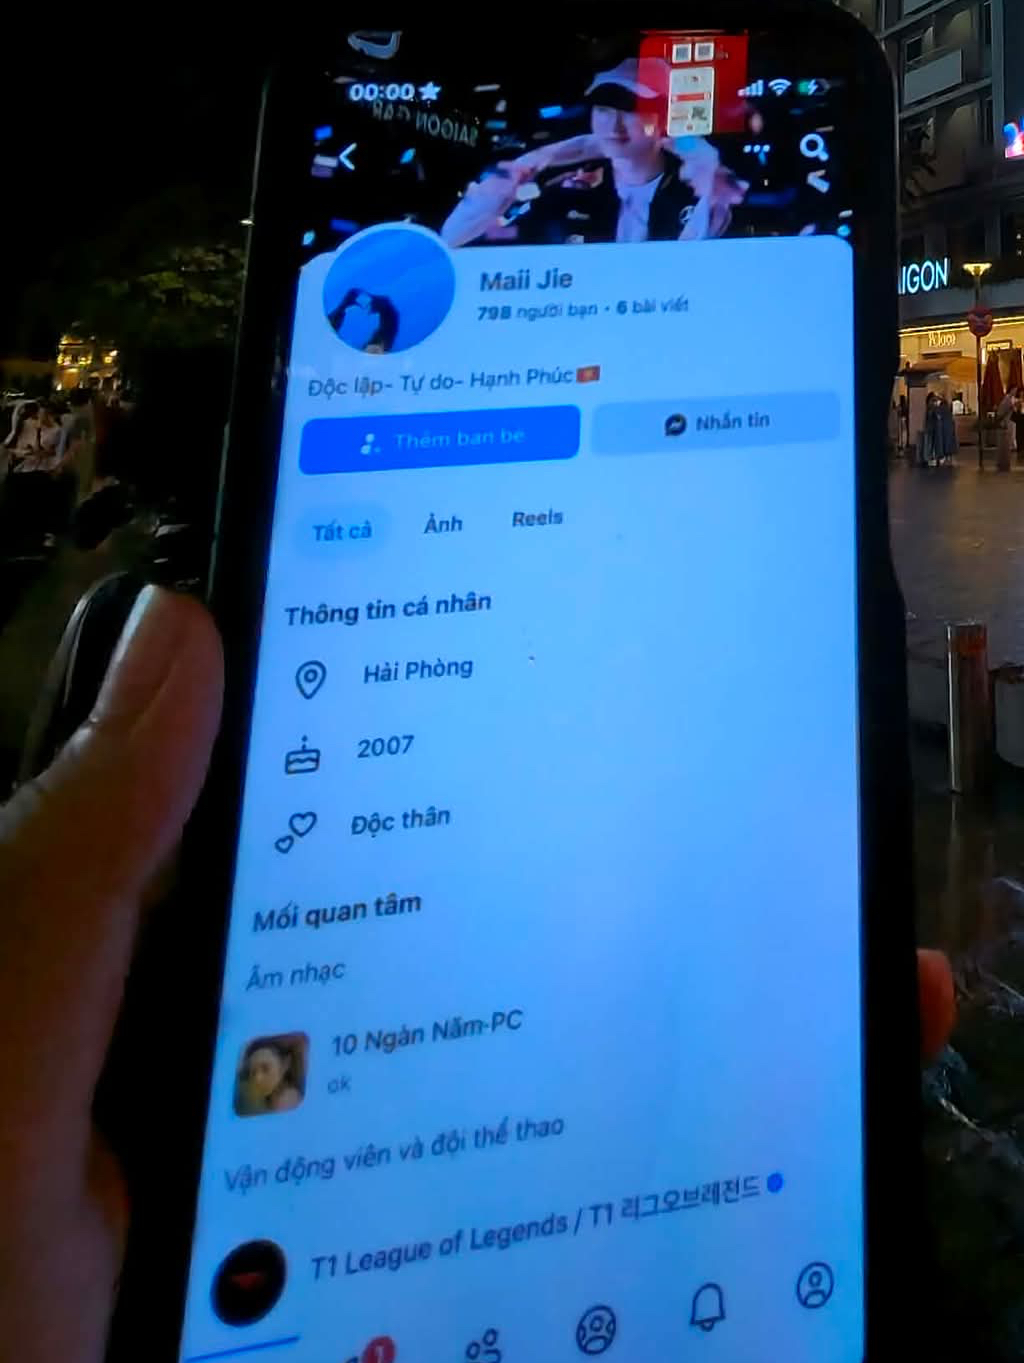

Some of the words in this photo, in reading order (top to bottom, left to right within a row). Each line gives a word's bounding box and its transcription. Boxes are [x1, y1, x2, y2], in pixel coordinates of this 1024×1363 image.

[349, 83, 416, 102] 00:00
[479, 269, 531, 292] Maii
[536, 267, 574, 289] Jie
[898, 256, 949, 295] IGON
[477, 305, 512, 321] 798
[566, 301, 599, 320] bạn
[616, 299, 629, 315] 6
[308, 378, 348, 400] Độc
[400, 374, 426, 395] Tự
[470, 370, 521, 391] Hạnh
[526, 366, 575, 384] Phúc
[748, 411, 771, 428] tin
[313, 518, 343, 542] Tất
[423, 512, 463, 534] Ảnh
[511, 508, 564, 528] Reels
[285, 603, 359, 626] Thông
[366, 599, 395, 620] tin
[402, 595, 428, 618] cá
[435, 591, 492, 615] nhân
[363, 662, 399, 684] Hải
[405, 658, 474, 681] Phòng
[356, 734, 415, 759] 2007
[350, 811, 396, 838] Độc
[402, 805, 452, 830] thân
[252, 900, 299, 933] Mối
[305, 901, 368, 930] quan
[374, 892, 423, 917] tâm
[246, 964, 283, 992] Âm
[290, 961, 346, 987] nhạc
[331, 1034, 358, 1057] 10
[327, 1076, 351, 1094] ok
[224, 1164, 267, 1196] Vận
[275, 1156, 336, 1187] động
[343, 1143, 392, 1171] viên
[399, 1137, 424, 1162] và
[431, 1129, 467, 1157] đội
[473, 1115, 509, 1150] thể
[516, 1116, 565, 1143] thao
[311, 1255, 337, 1280] T1
[345, 1243, 433, 1275] League
[438, 1229, 465, 1256] of
[470, 1211, 569, 1251] Legends
[589, 1202, 613, 1228] T1
